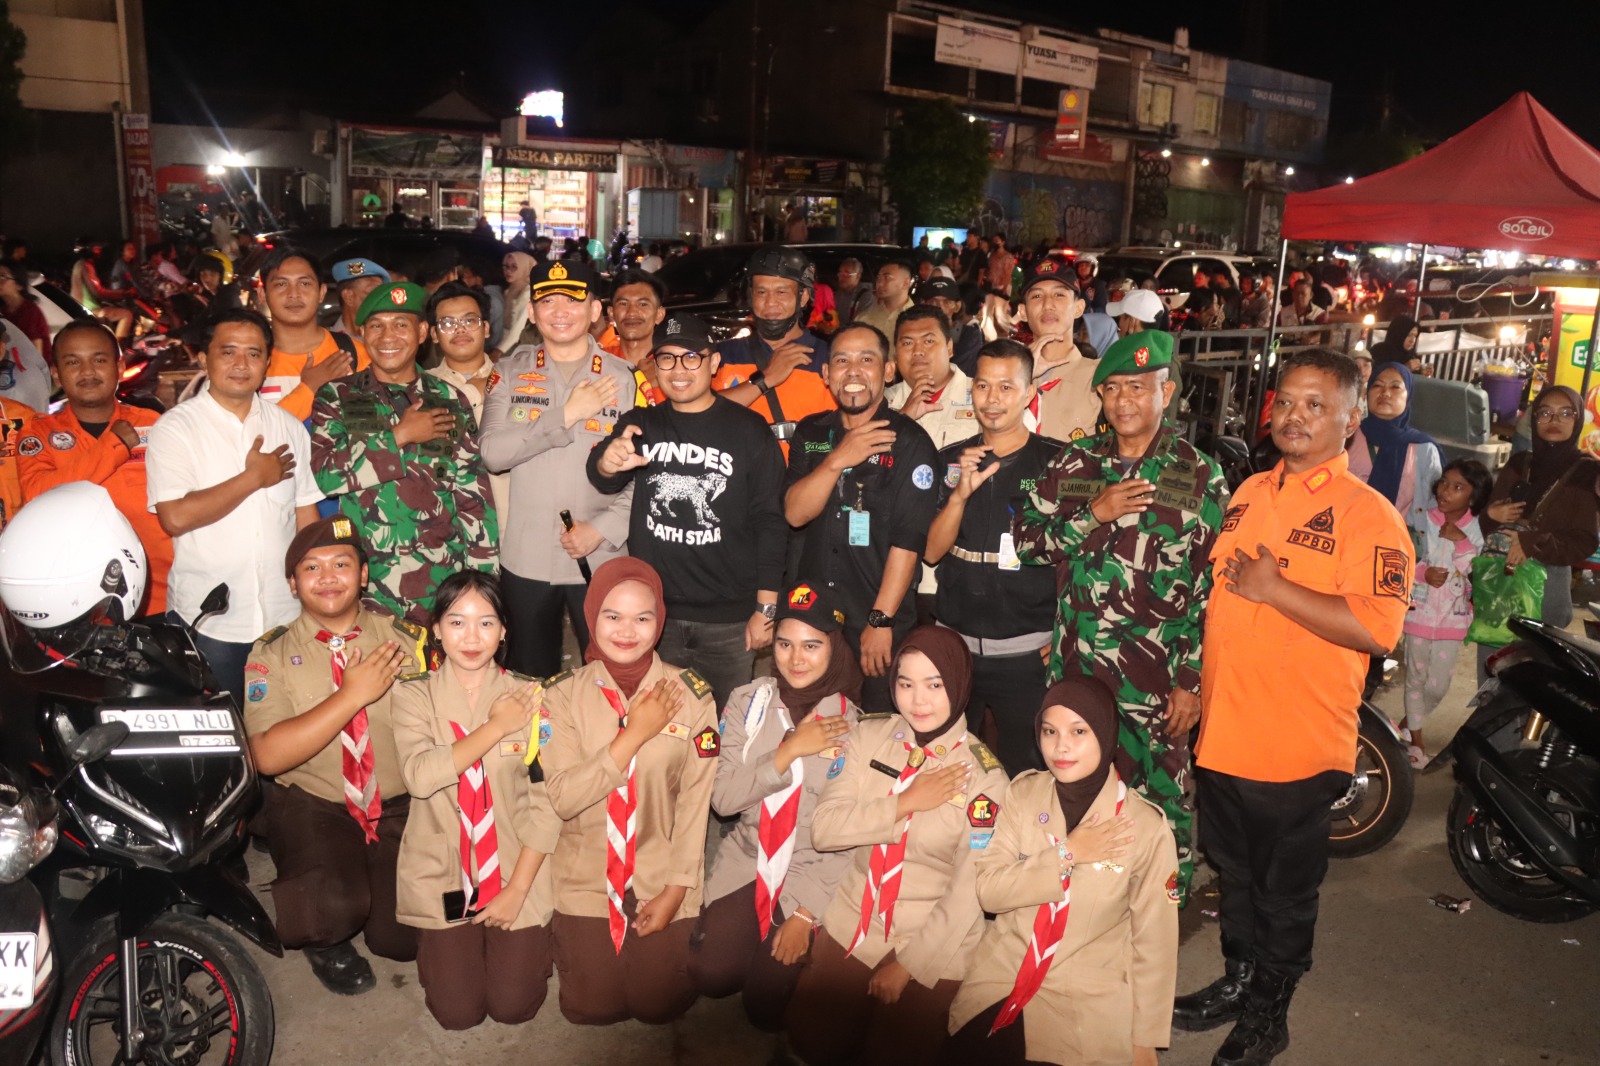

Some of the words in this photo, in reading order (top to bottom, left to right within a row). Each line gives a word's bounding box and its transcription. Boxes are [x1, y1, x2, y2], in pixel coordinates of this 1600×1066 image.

[1026, 45, 1058, 60] YUASA
[1070, 54, 1099, 67] BATTERY
[553, 152, 616, 167] PARFUM
[642, 441, 734, 477] VINDES
[1020, 478, 1036, 486] NCC
[685, 526, 722, 546] STAR
[1292, 532, 1332, 551] BPBD
[133, 713, 180, 730] 4991
[193, 712, 230, 729] NLU
[153, 940, 204, 960] VARIO
